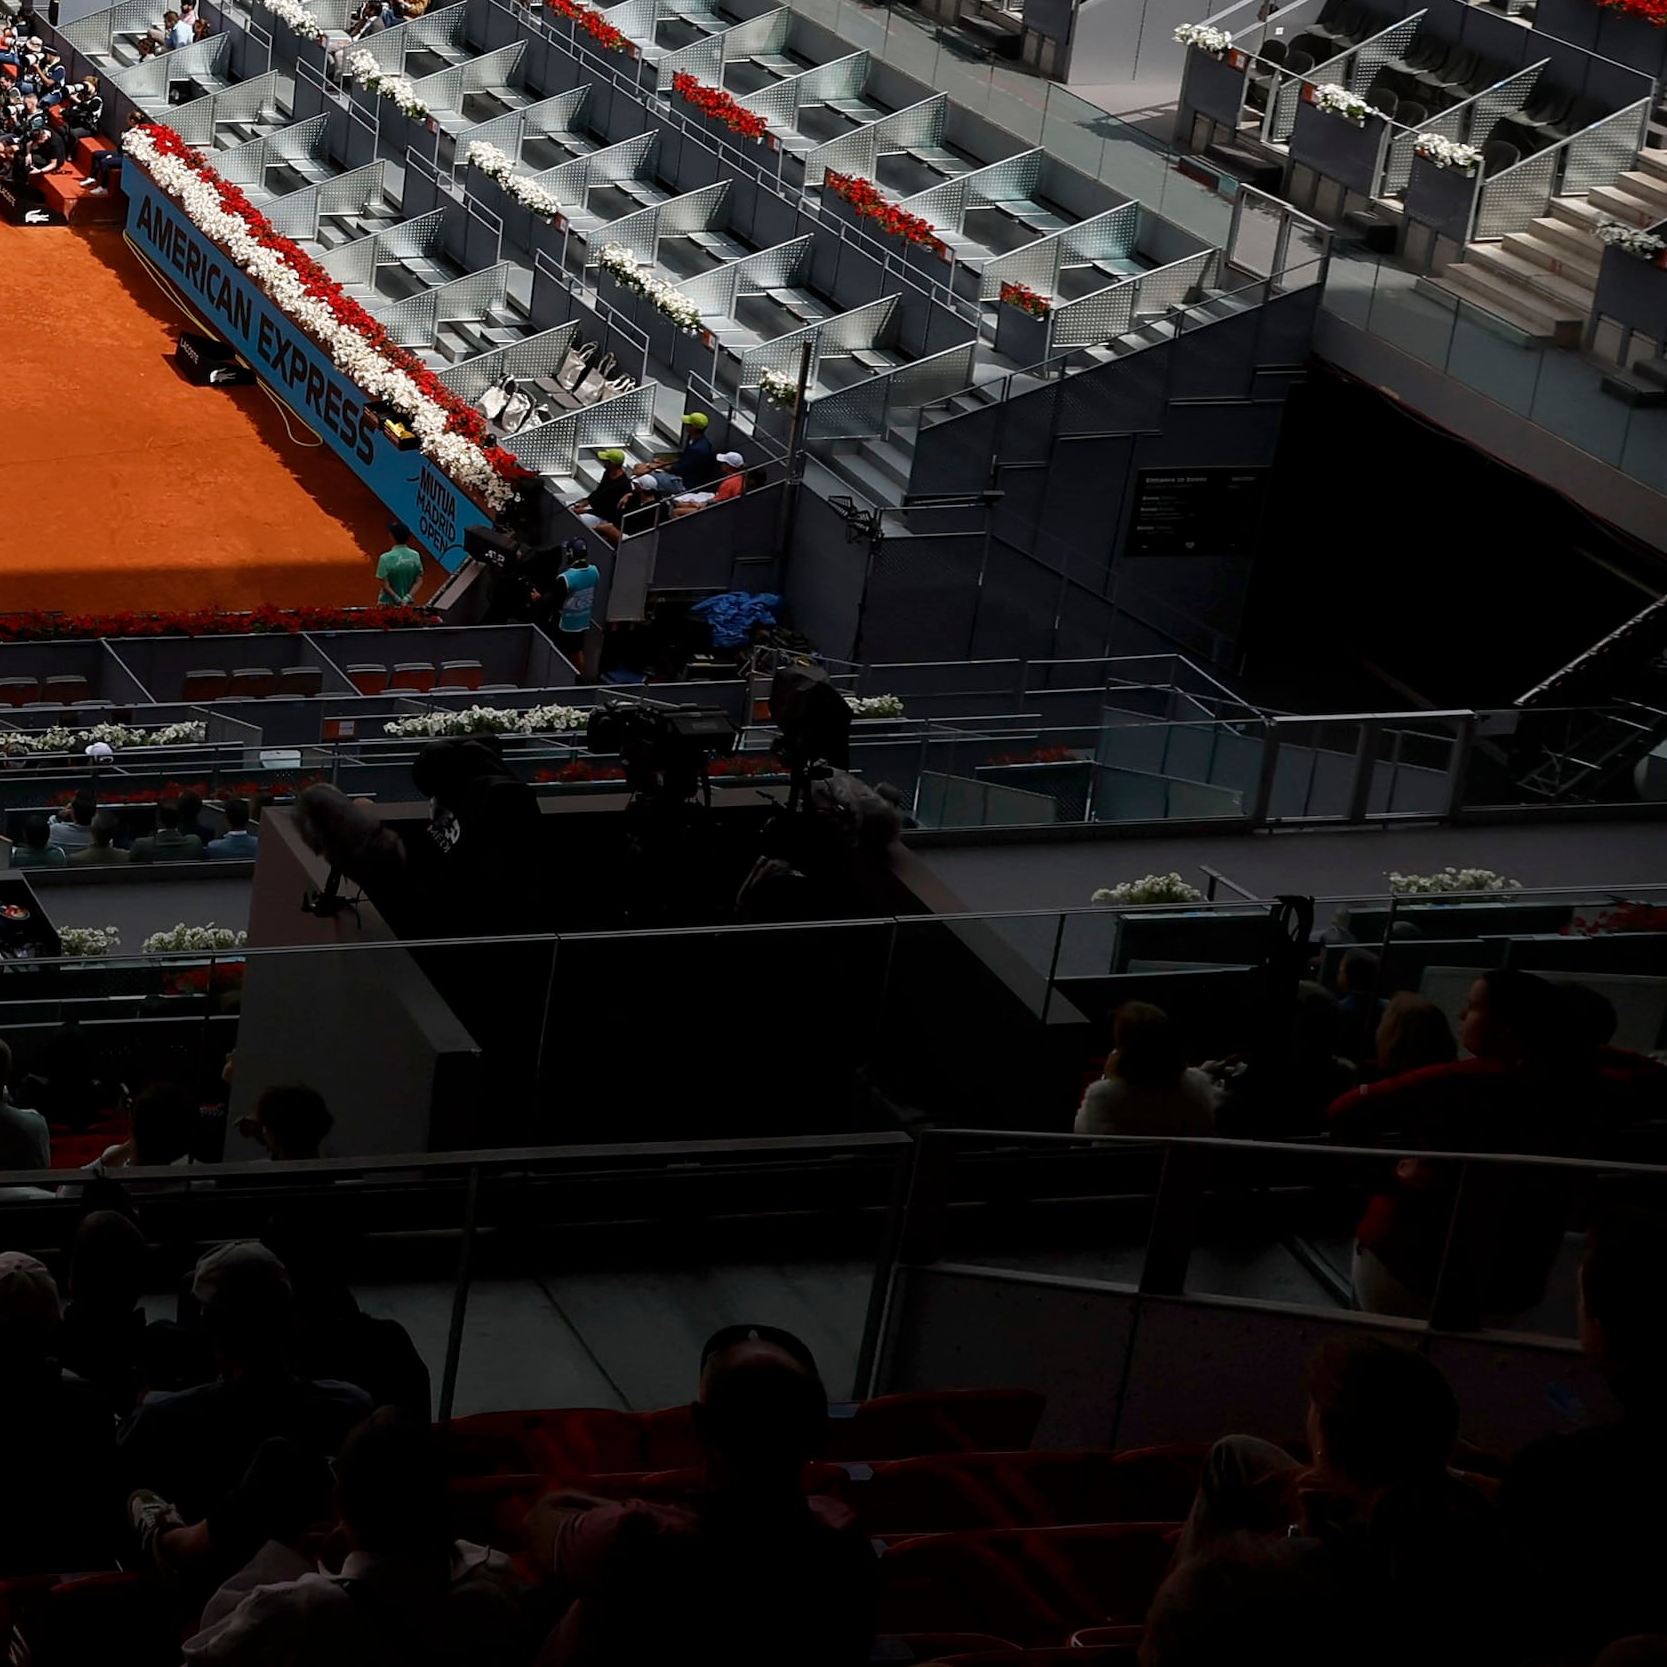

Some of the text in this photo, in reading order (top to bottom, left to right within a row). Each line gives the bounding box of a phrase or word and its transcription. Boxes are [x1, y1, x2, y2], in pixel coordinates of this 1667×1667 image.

[136, 195, 375, 465] AMERICAN EXPRESS
[416, 491, 456, 542] MADRID
[420, 465, 456, 519] MUTUA
[419, 516, 448, 554] OPEN
